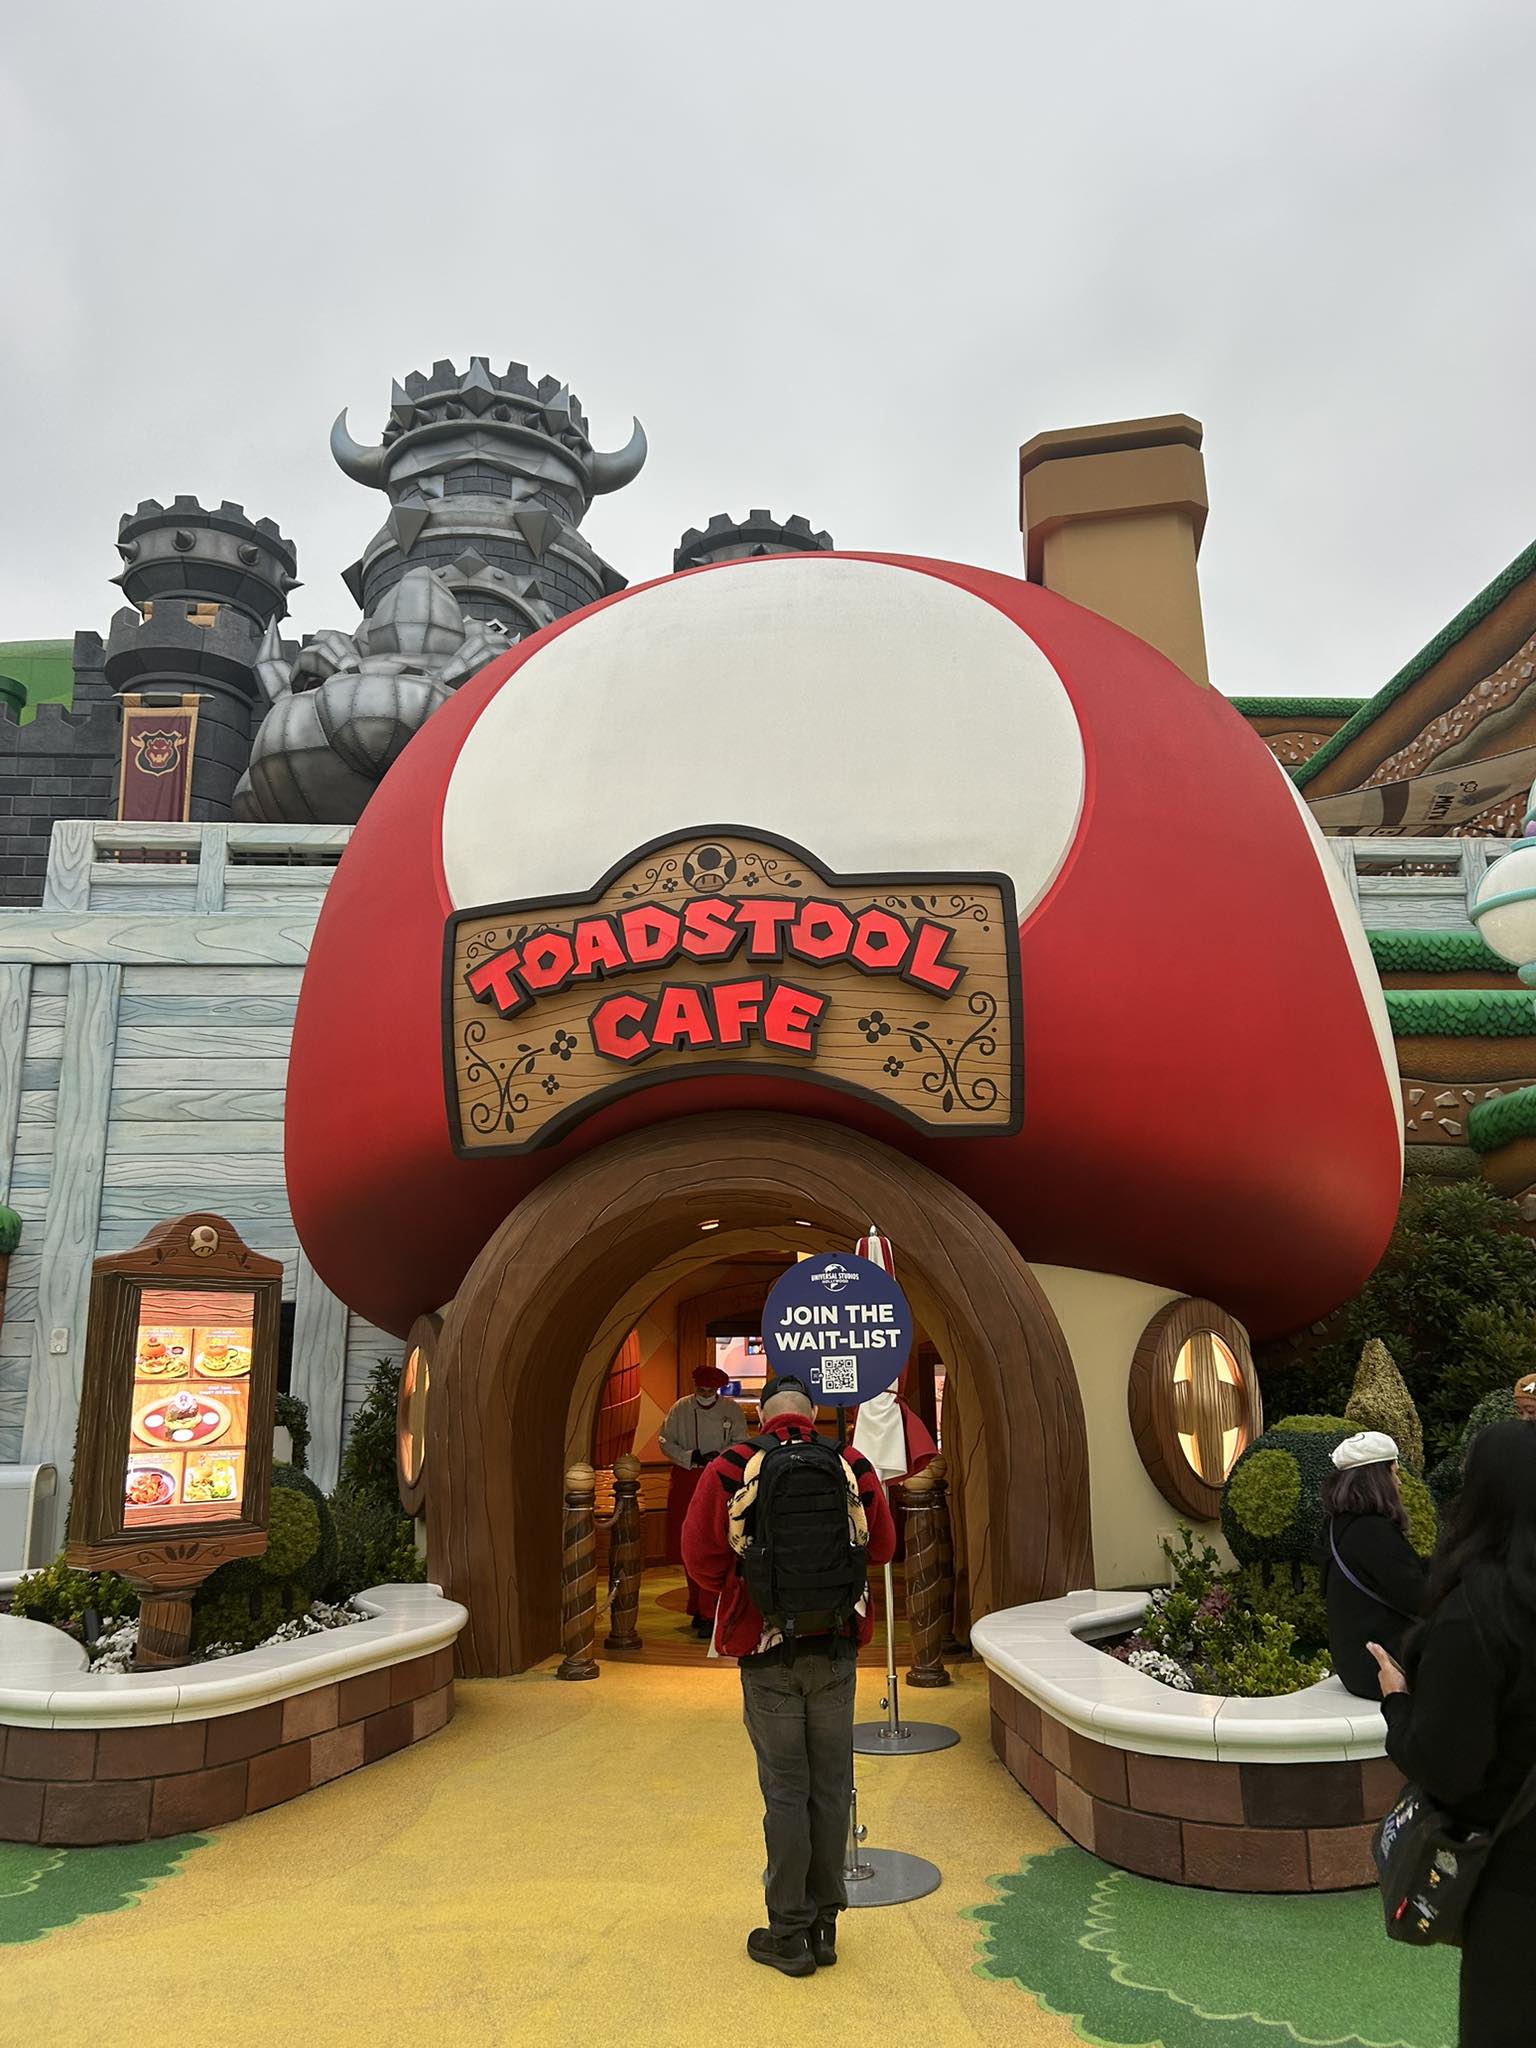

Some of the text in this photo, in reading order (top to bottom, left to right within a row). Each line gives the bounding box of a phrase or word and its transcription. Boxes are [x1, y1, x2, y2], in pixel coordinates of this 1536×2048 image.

[1428, 795, 1455, 820] MKTV
[468, 898, 971, 1011] TOADSTOOL
[592, 979, 825, 1060] CAFE
[811, 1273, 838, 1281] UNIVERSAL
[780, 1304, 894, 1326] JOIN THE
[775, 1329, 901, 1351] WAIT-LIST
